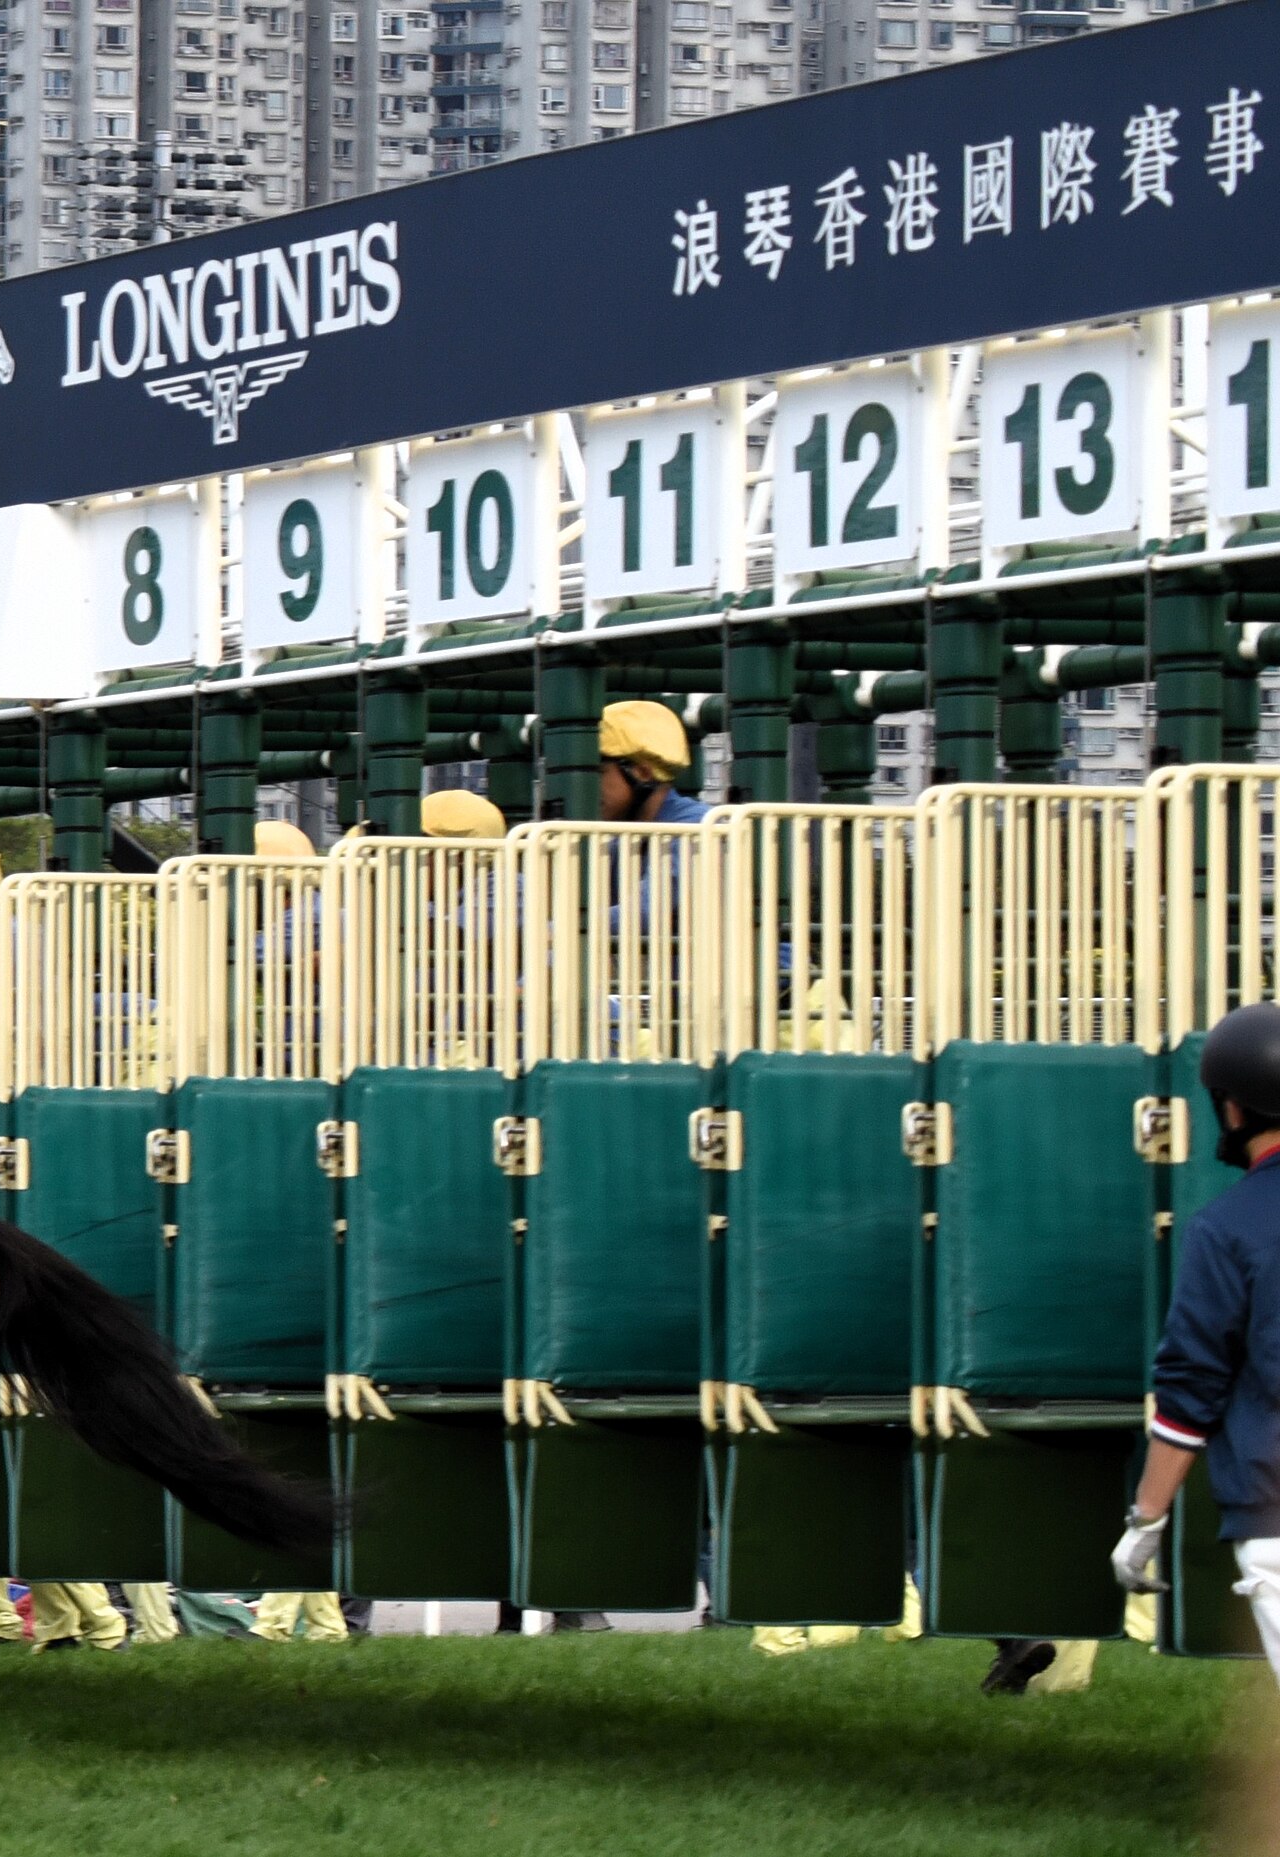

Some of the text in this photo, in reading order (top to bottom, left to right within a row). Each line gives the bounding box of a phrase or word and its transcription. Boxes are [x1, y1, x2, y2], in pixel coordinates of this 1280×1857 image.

[671, 87, 1264, 296] 浪琴香港國際賽事
[61, 221, 401, 387] LONGINES
[795, 402, 898, 548] 12
[1004, 372, 1115, 519] 13
[1228, 339, 1270, 489] 1
[278, 498, 324, 622] 9
[427, 469, 514, 600] 10
[609, 432, 694, 573] 11
[122, 526, 164, 646] 8
